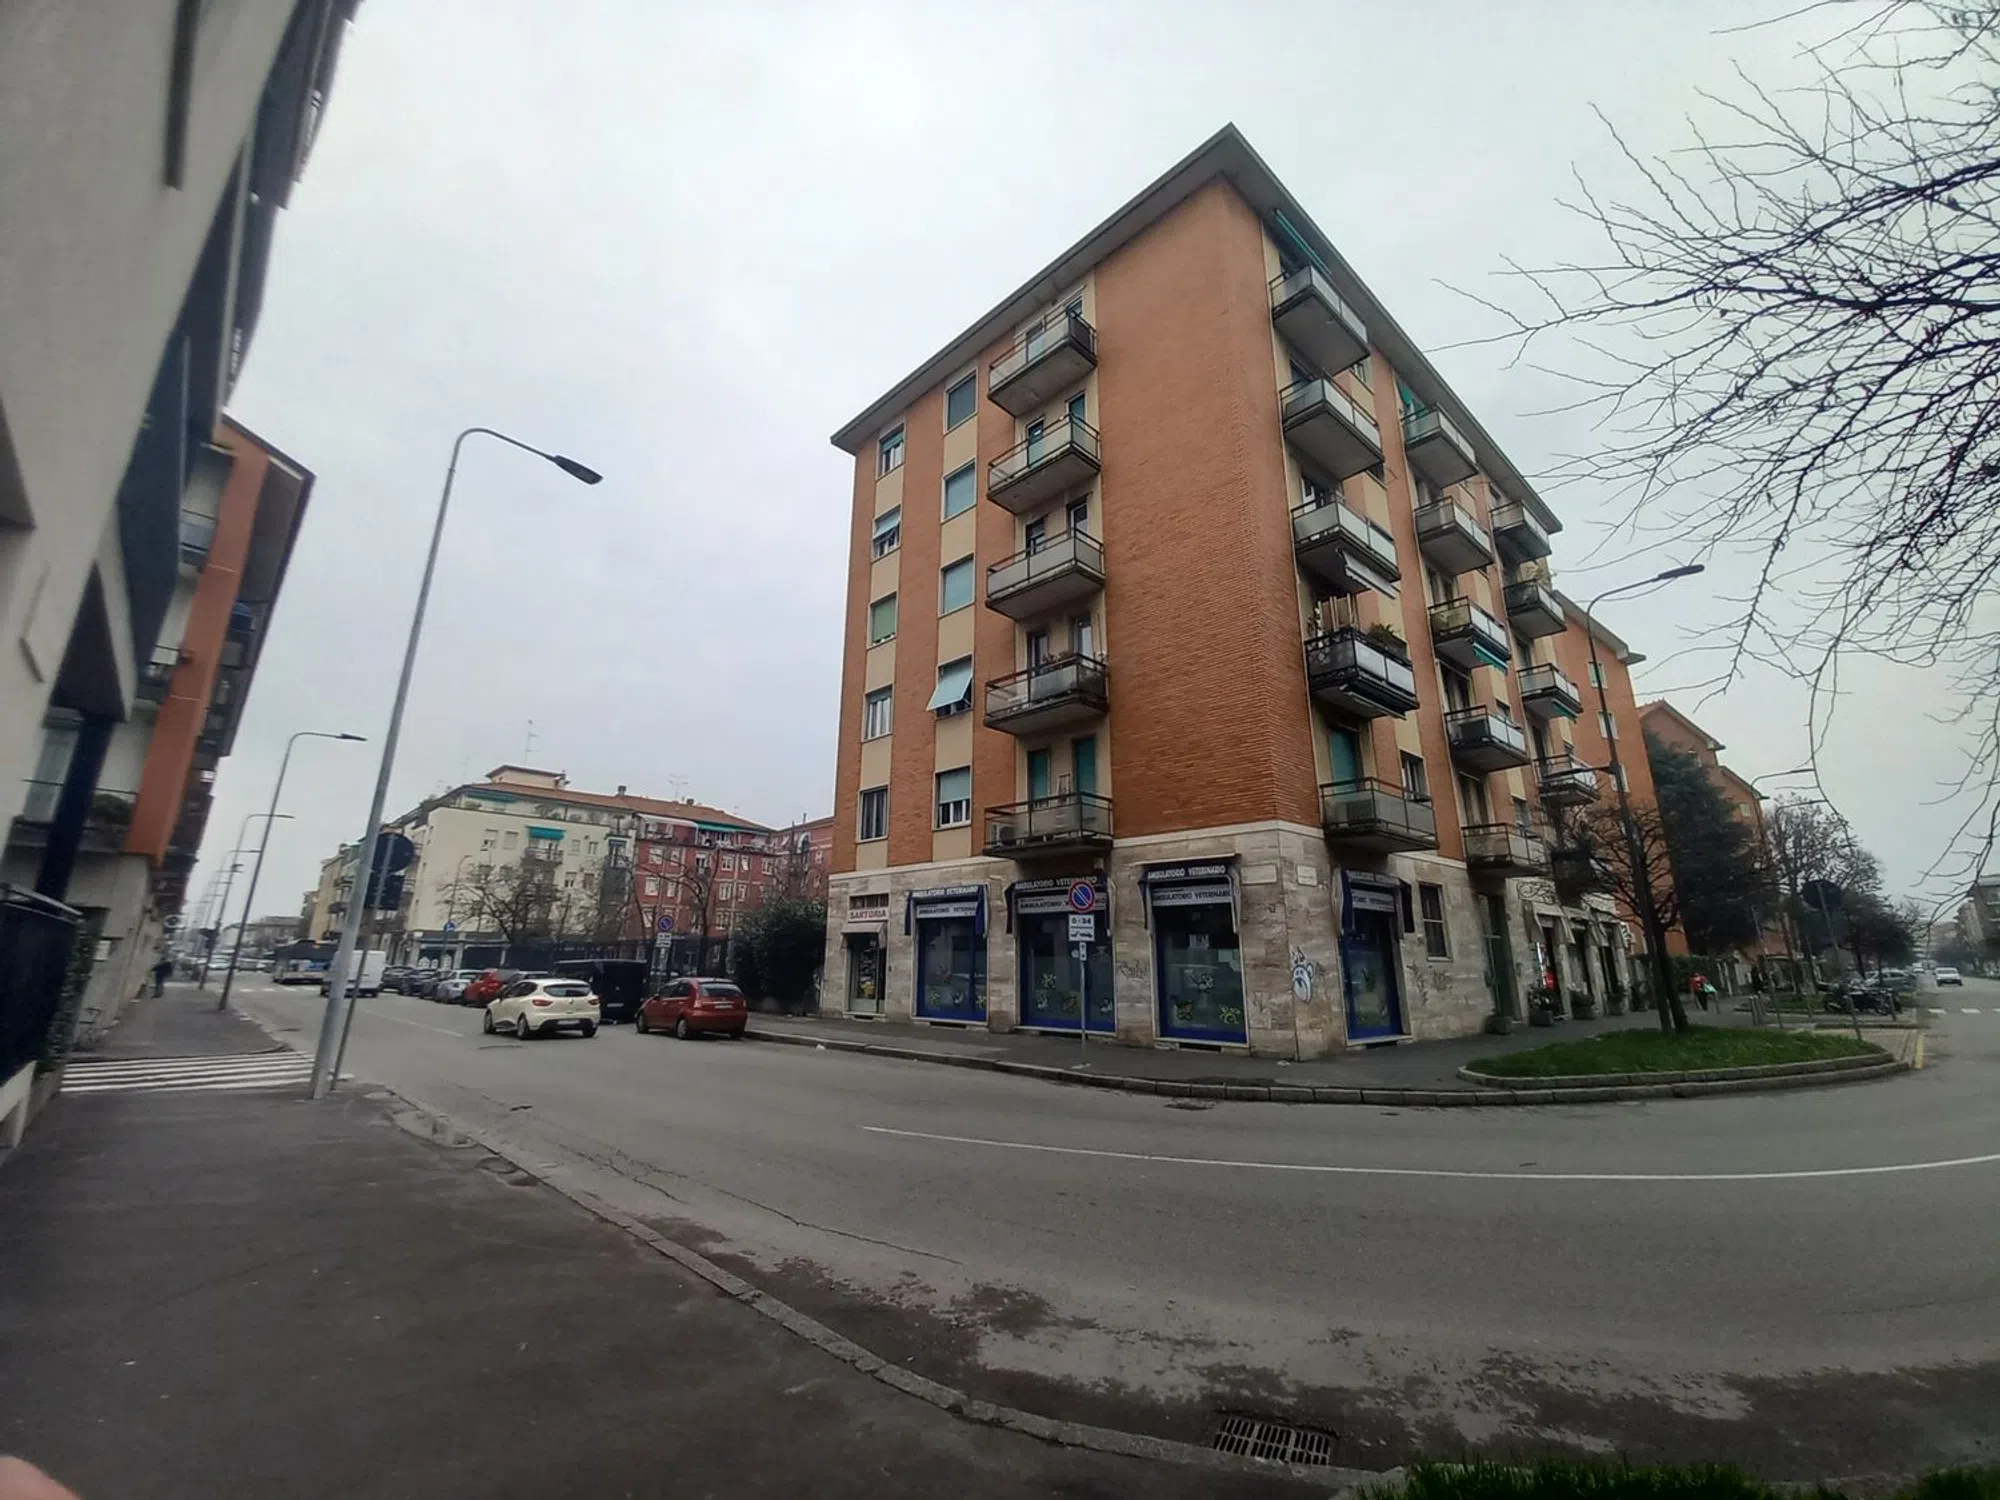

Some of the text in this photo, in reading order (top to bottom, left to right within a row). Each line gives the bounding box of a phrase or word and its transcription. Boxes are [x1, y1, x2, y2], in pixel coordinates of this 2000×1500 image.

[1147, 865, 1226, 878] AMBULATORIO VETERINARIO
[850, 909, 887, 920] SARTORIA
